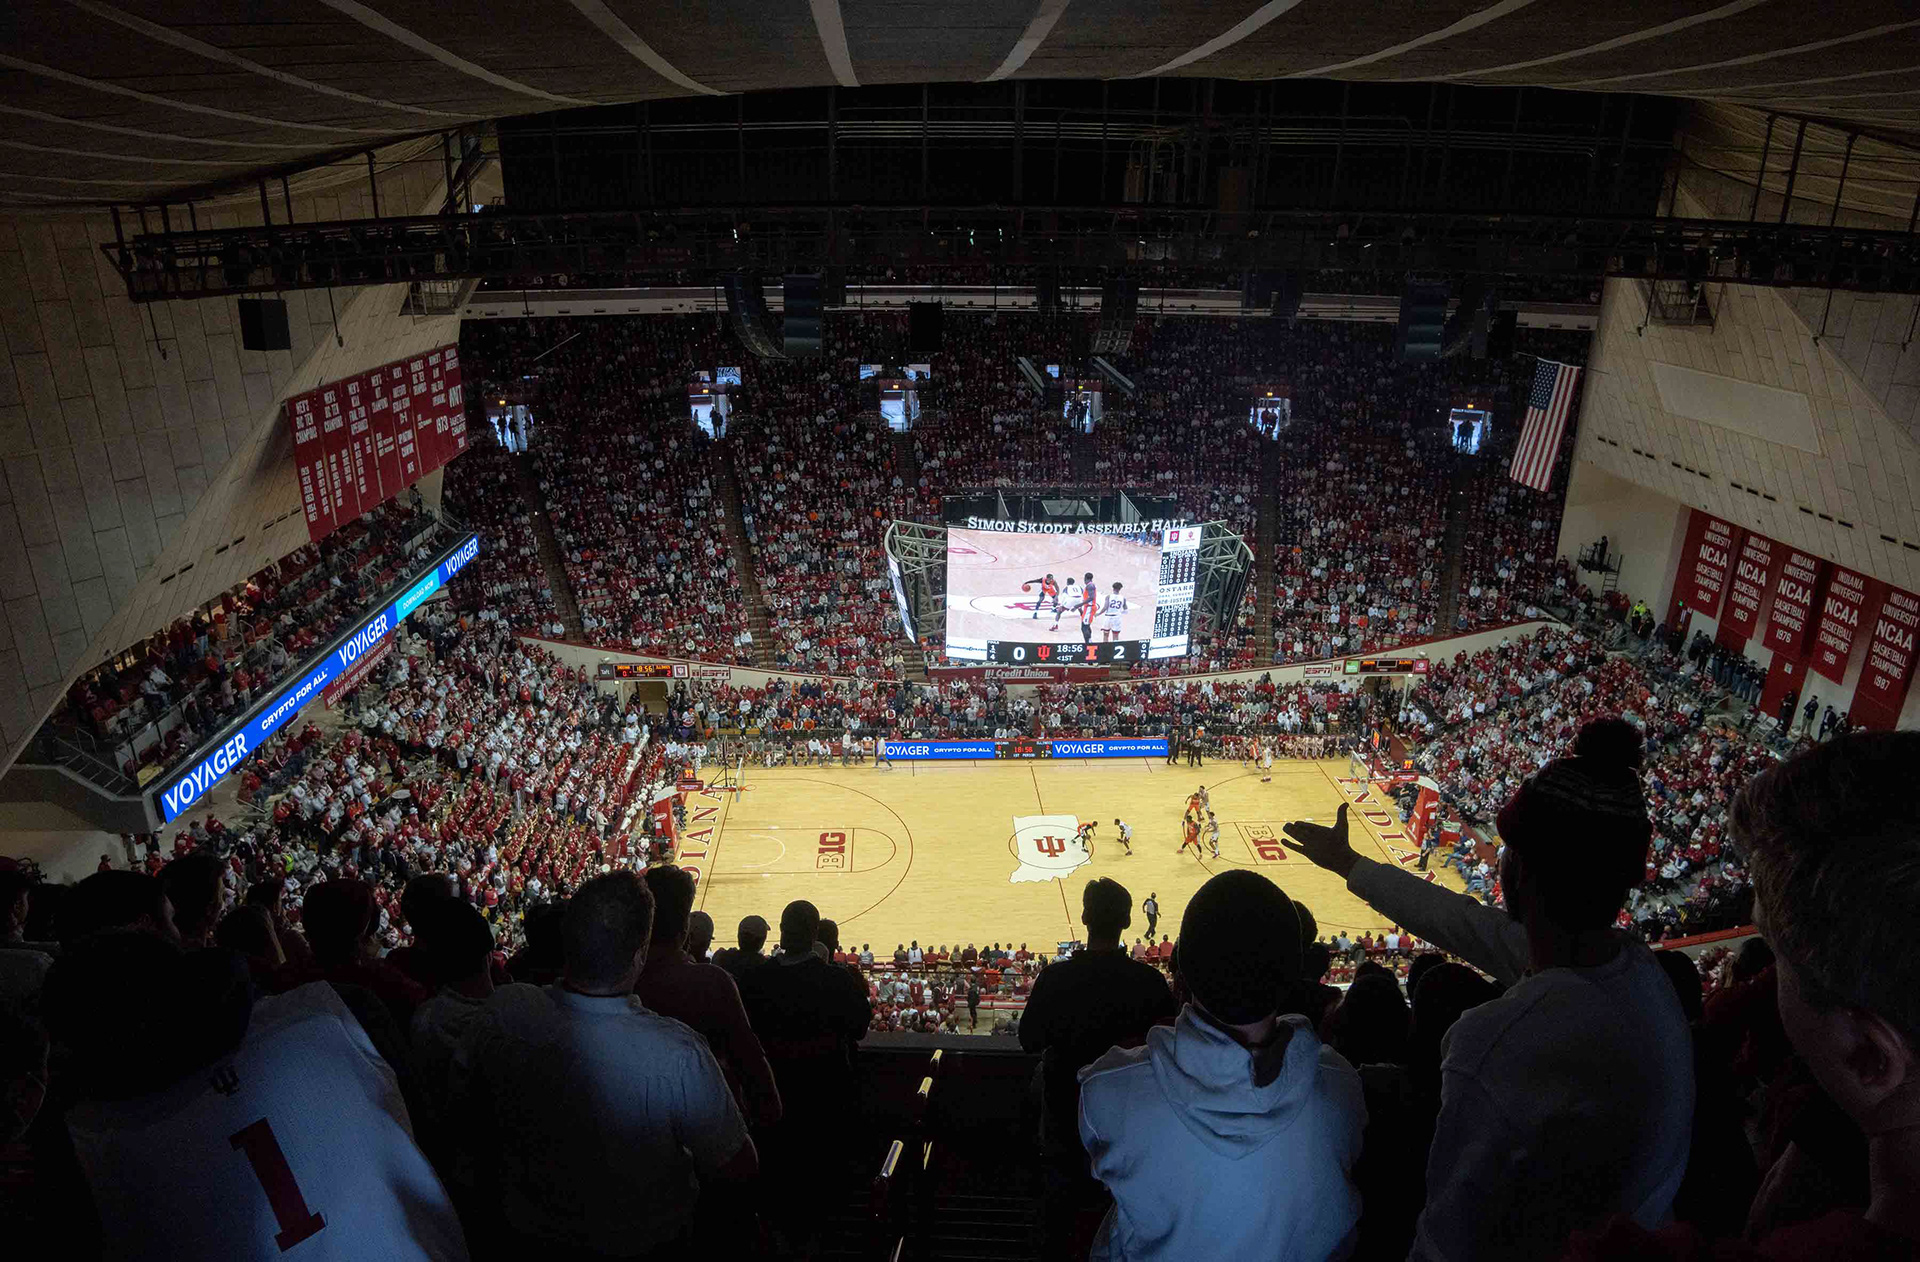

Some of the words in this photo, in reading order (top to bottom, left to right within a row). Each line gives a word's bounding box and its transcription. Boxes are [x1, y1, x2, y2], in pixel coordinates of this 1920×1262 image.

[968, 516, 1014, 532] SIMON
[1017, 520, 1072, 534] SKJODT
[1075, 522, 1149, 535] ASSEMBLY
[1151, 518, 1187, 532] HALL
[1709, 520, 1730, 535] INDIANA
[1704, 530, 1732, 549] UNIVERSITY
[1748, 535, 1771, 553] INDIANA
[445, 538, 478, 575] VOYAGER
[1699, 544, 1728, 568] NCAA
[1743, 546, 1771, 566] UNIVERSITY
[1791, 552, 1815, 571] INDIANA
[1696, 562, 1724, 582] BASKETBALL
[1737, 560, 1767, 586] NCAA
[1784, 564, 1816, 585] UNIVERSITY
[1838, 570, 1864, 591] INDIANA
[1695, 574, 1720, 592] CHAMPIONS
[1734, 579, 1761, 600] BASKETBALL
[1777, 578, 1812, 606] NCAA
[402, 588, 425, 610] DOWNLOAD
[1110, 600, 1122, 609] 23
[1732, 592, 1759, 611] CHAMPIONS
[1830, 582, 1865, 606] UNIVERSITY
[1890, 592, 1920, 613] INDIANA
[1774, 598, 1806, 621] BASKETBALL
[1824, 597, 1858, 627] NCAA
[1882, 603, 1920, 628] UNIVERSITY
[1772, 611, 1802, 632] CHAMPIONS
[1821, 618, 1853, 642] BASKETBALL
[338, 614, 389, 666] VOYAGER
[1776, 628, 1792, 643] 1976
[1819, 631, 1849, 653] CHAMPIONS
[1875, 619, 1913, 652] NCAA
[1013, 647, 1025, 660] 0
[1057, 644, 1083, 653] 18:56
[1113, 645, 1125, 659] 2
[1872, 641, 1907, 668] BASKETBALL
[996, 669, 1022, 677] Credit
[1024, 668, 1049, 677] Union
[1870, 655, 1903, 680] CHAMPIONS
[1874, 675, 1891, 691] 1987
[262, 697, 295, 730] CRYPTO
[296, 682, 312, 701] FOR
[313, 671, 328, 689] ALL
[1055, 744, 1104, 754] VOYAGER
[165, 733, 248, 813] VOYAGER
[228, 1117, 326, 1252] 1
